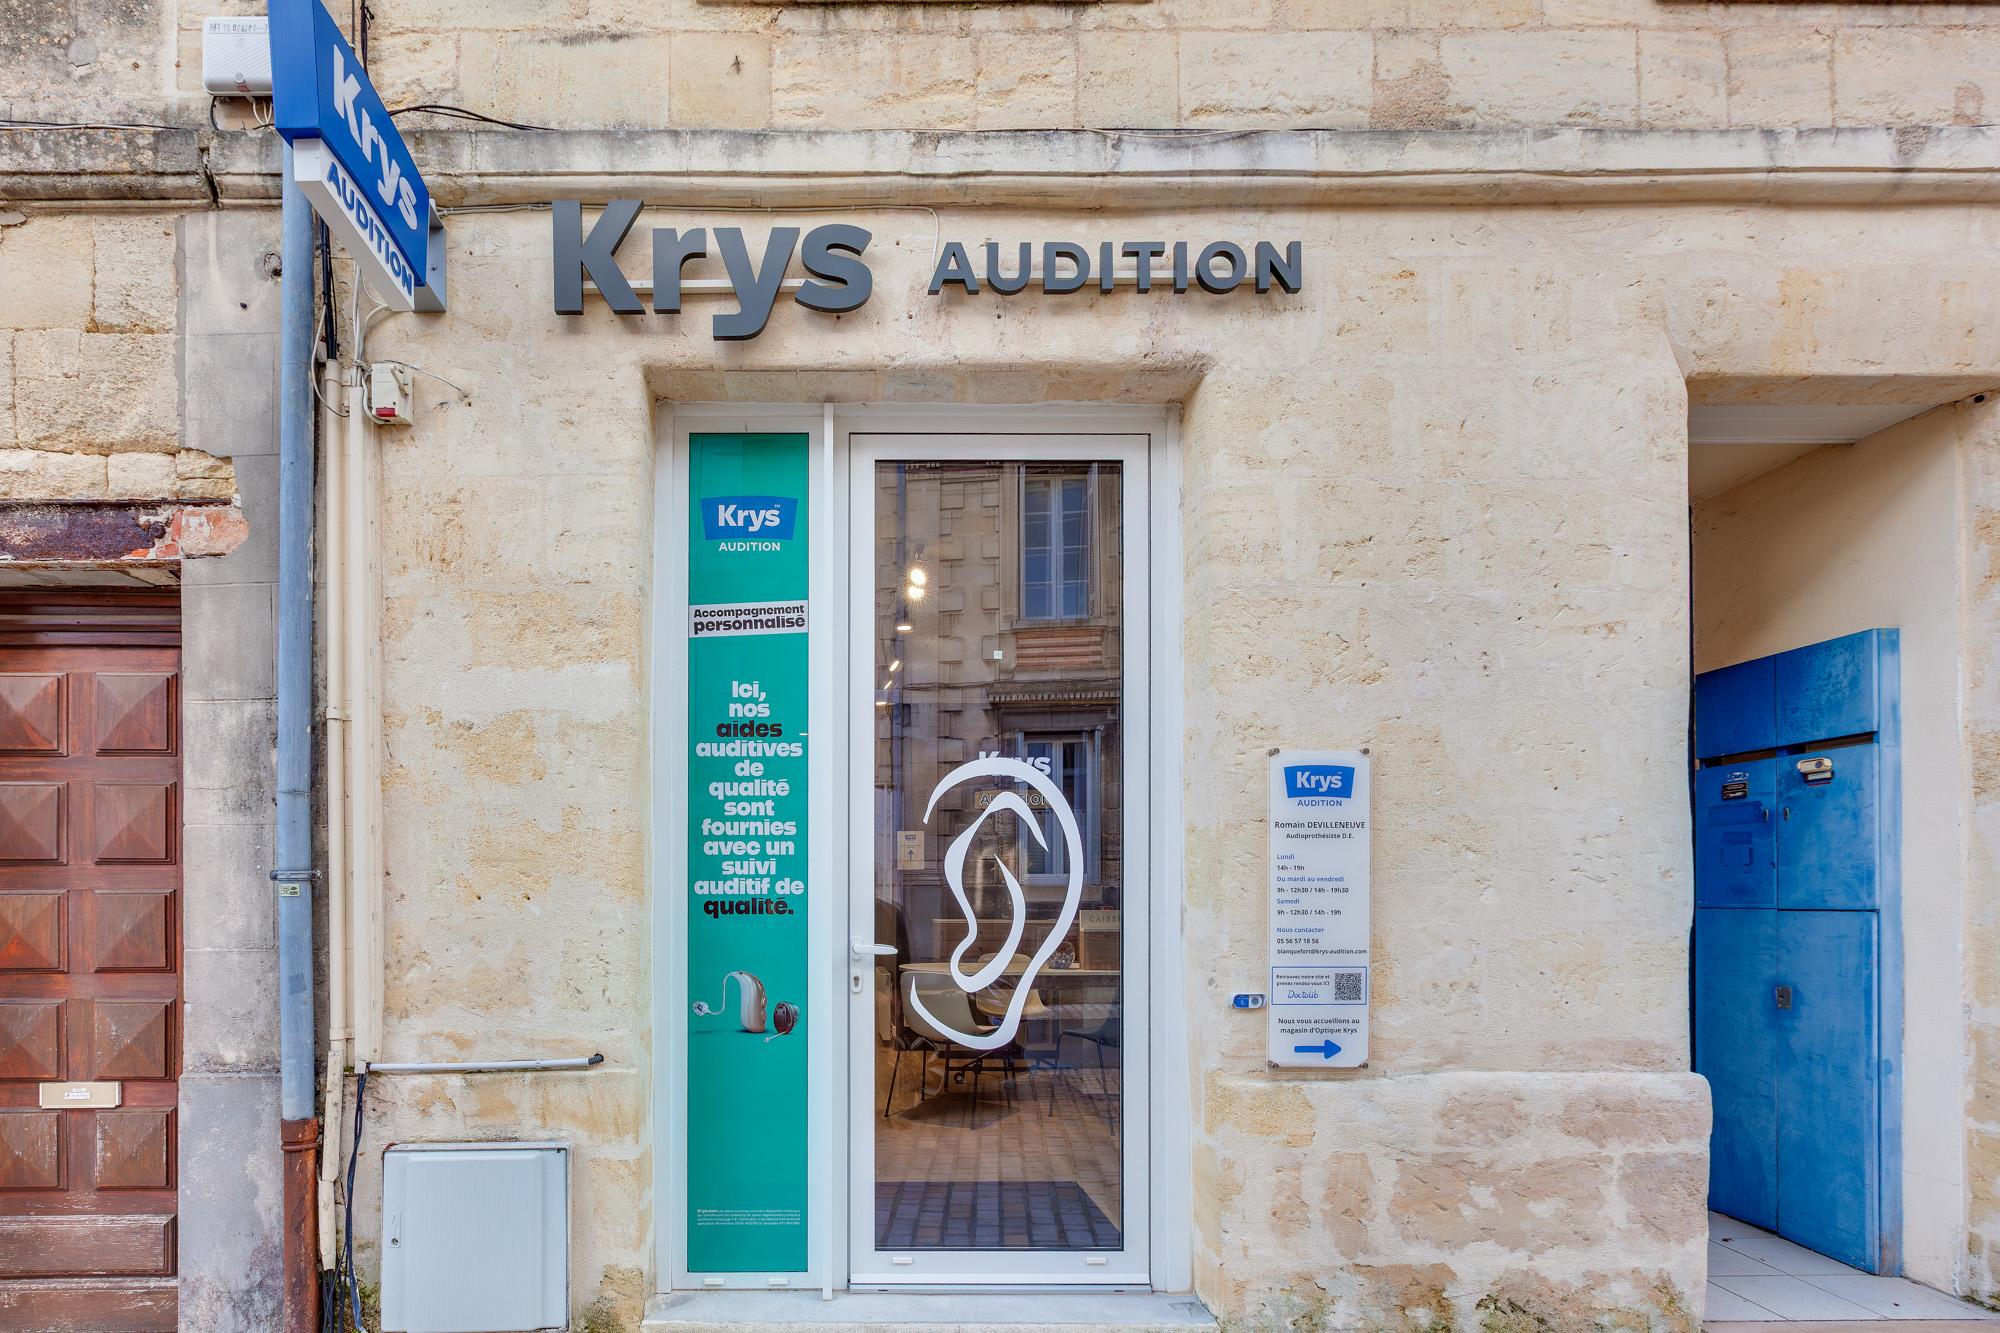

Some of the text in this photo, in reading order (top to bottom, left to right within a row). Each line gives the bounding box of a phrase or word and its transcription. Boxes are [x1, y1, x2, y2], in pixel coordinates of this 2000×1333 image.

[333, 44, 417, 230] Krys
[326, 161, 413, 296] AUDITION
[552, 199, 1302, 341] Krys AUDITION
[718, 542, 781, 552] AUDITION
[693, 604, 805, 619] Accompagnement
[693, 614, 806, 635] personnalisé
[732, 680, 767, 702] Ici,
[729, 702, 771, 718] nos
[716, 719, 783, 738] aides
[695, 739, 803, 757] auditives
[734, 759, 764, 777] de
[708, 778, 790, 800] qualité
[723, 799, 775, 816] sont
[1297, 799, 1343, 807] AUDITION
[701, 818, 797, 836] fournies
[1274, 821, 1366, 829] Romain DEVILLENEUVE
[1285, 832, 1341, 840] Audioprothésiste
[703, 840, 795, 856] avec un
[721, 858, 776, 875] suivi
[693, 877, 805, 895] auditif de
[703, 896, 794, 919] qualité.
[1287, 989, 1319, 999] Doctolib
[1280, 1027, 1358, 1035] magasin d'Optique Krys
